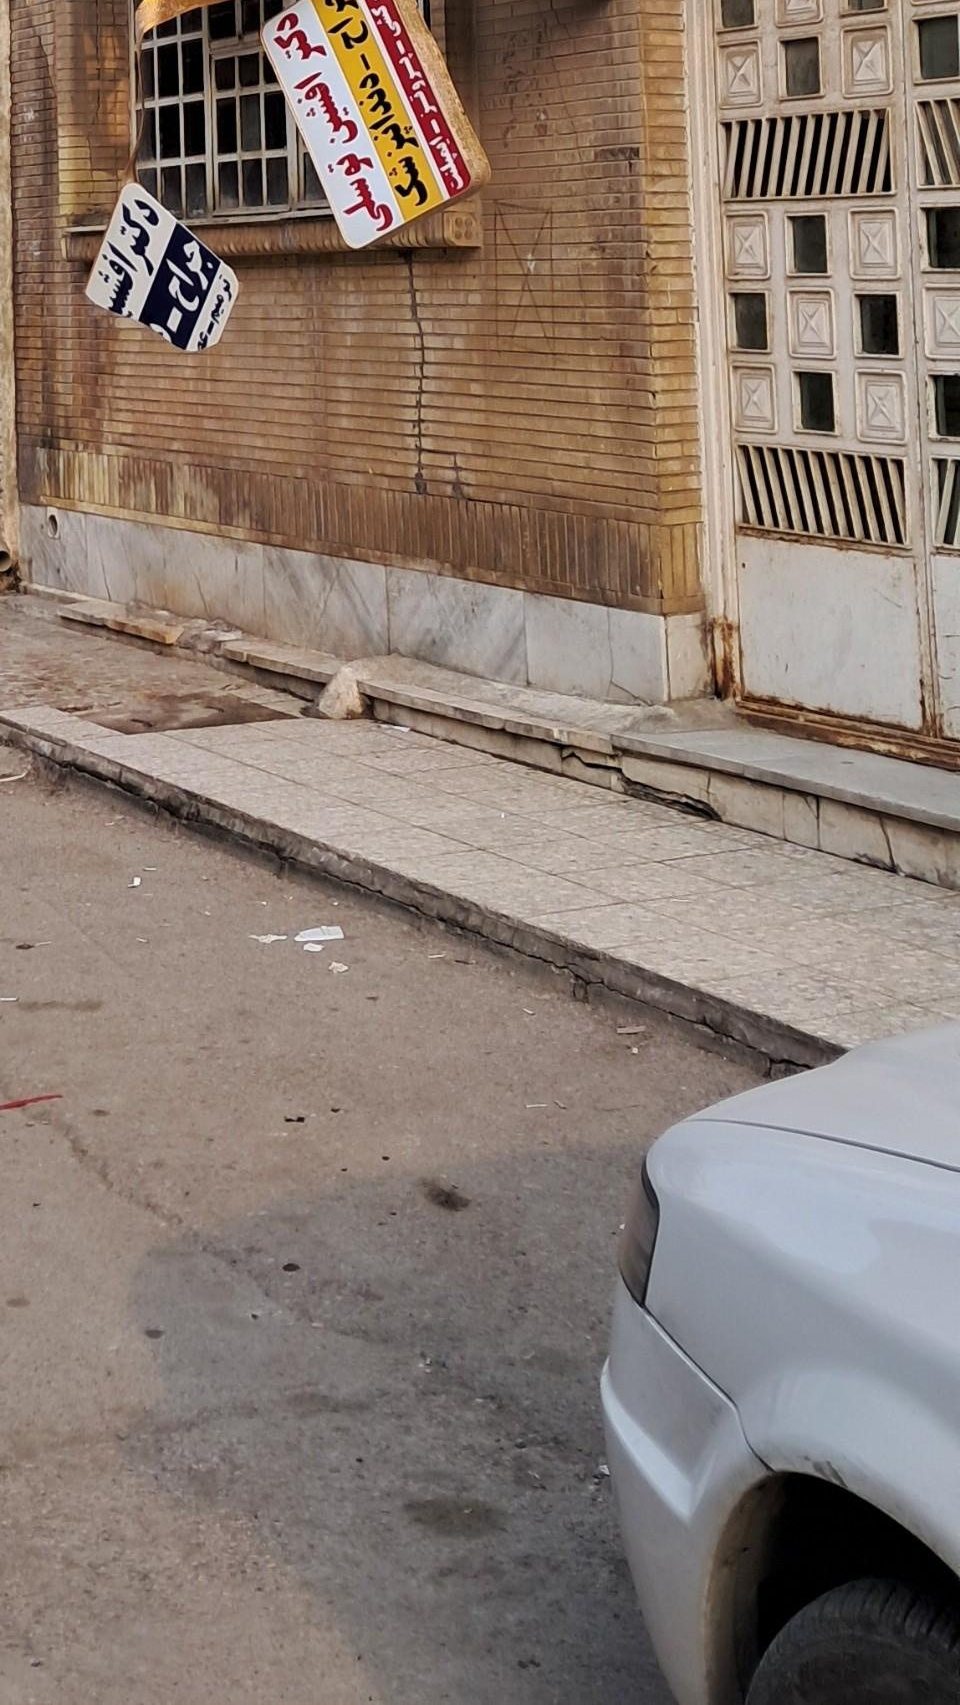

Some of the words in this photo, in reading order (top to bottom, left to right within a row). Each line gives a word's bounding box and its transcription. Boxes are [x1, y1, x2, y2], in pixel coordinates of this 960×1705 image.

[274, 12, 328, 61] دکتر
[294, 71, 358, 144] افشین
[359, 72, 428, 207] دندانپزشک
[398, 51, 438, 119] پروتز
[429, 134, 464, 191] ایمپلنت
[328, 152, 394, 232] توسلی
[120, 199, 160, 277] دکتر
[165, 240, 214, 312] جراح
[98, 240, 139, 319] افشی
